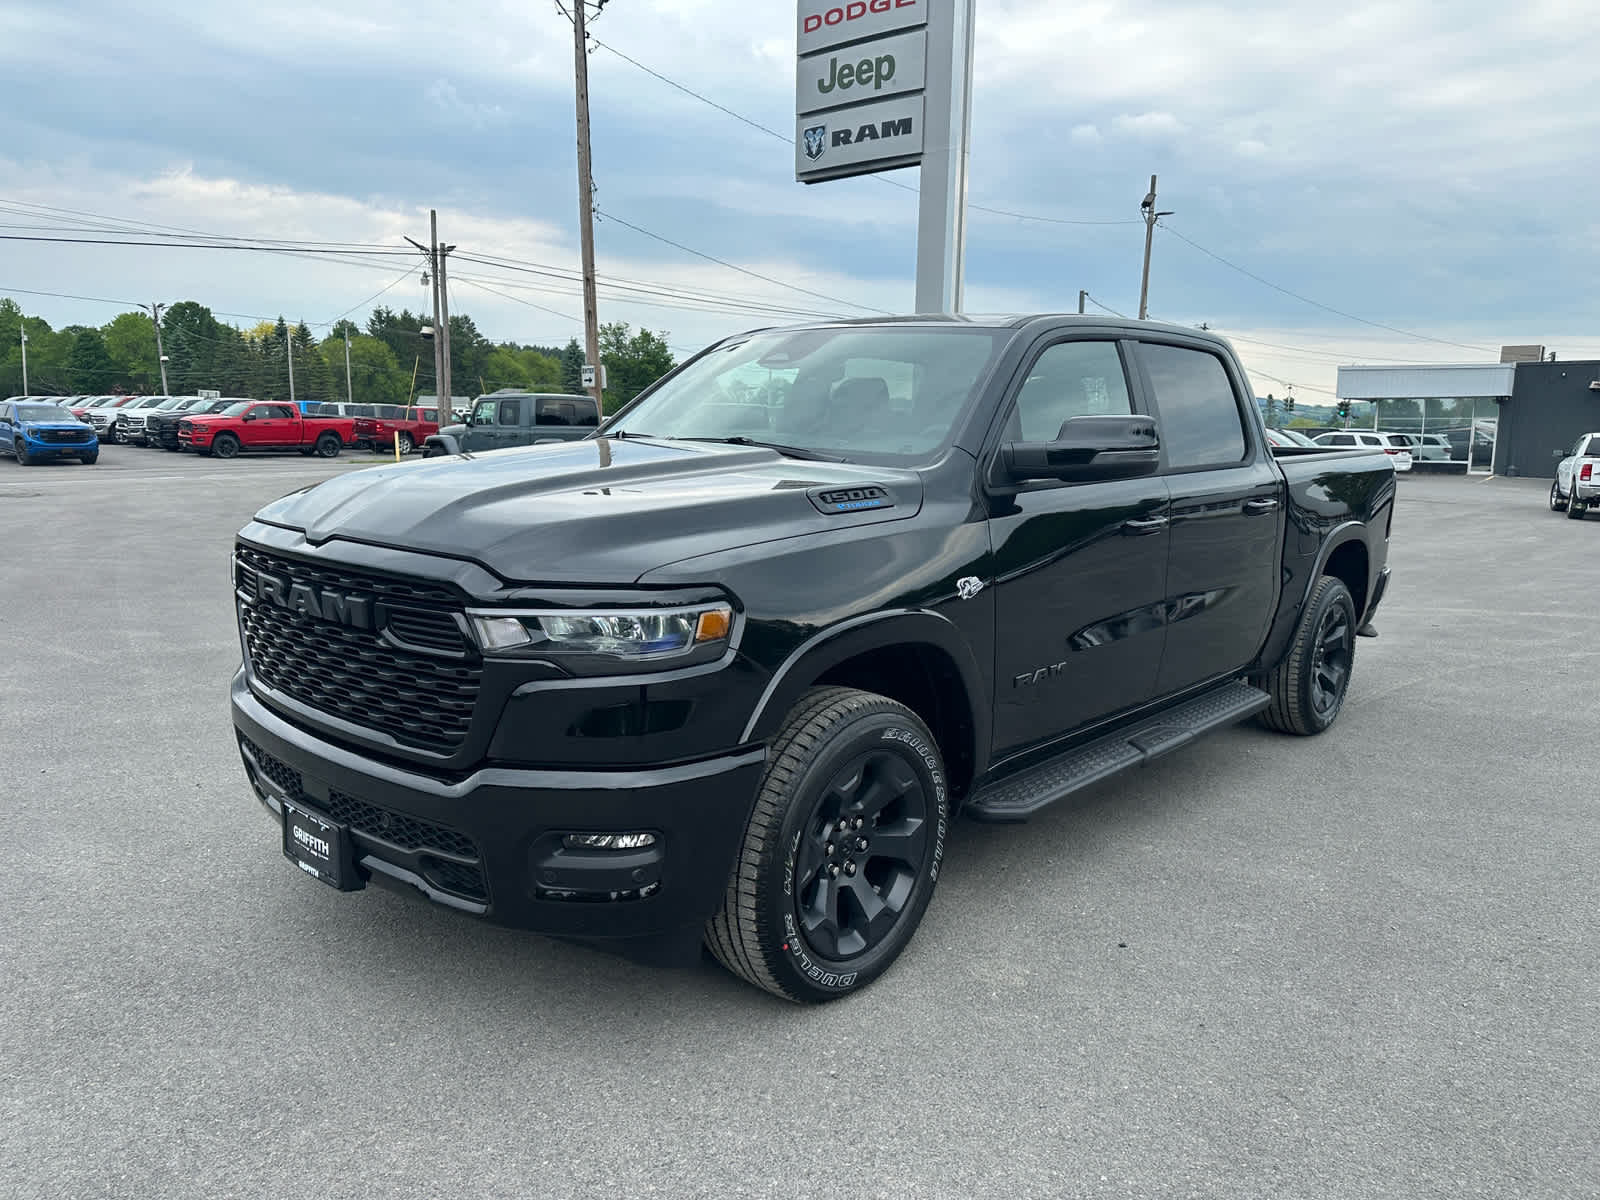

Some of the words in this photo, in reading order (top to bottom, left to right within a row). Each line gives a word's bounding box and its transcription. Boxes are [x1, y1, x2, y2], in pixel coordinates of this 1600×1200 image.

[817, 54, 896, 94] Jeep
[831, 117, 913, 148] RAM
[820, 487, 881, 504] 1500
[257, 571, 369, 629] RAM
[1013, 661, 1068, 689] RAM
[293, 825, 330, 856] GRIFFITH
[784, 913, 858, 987] DUELER
